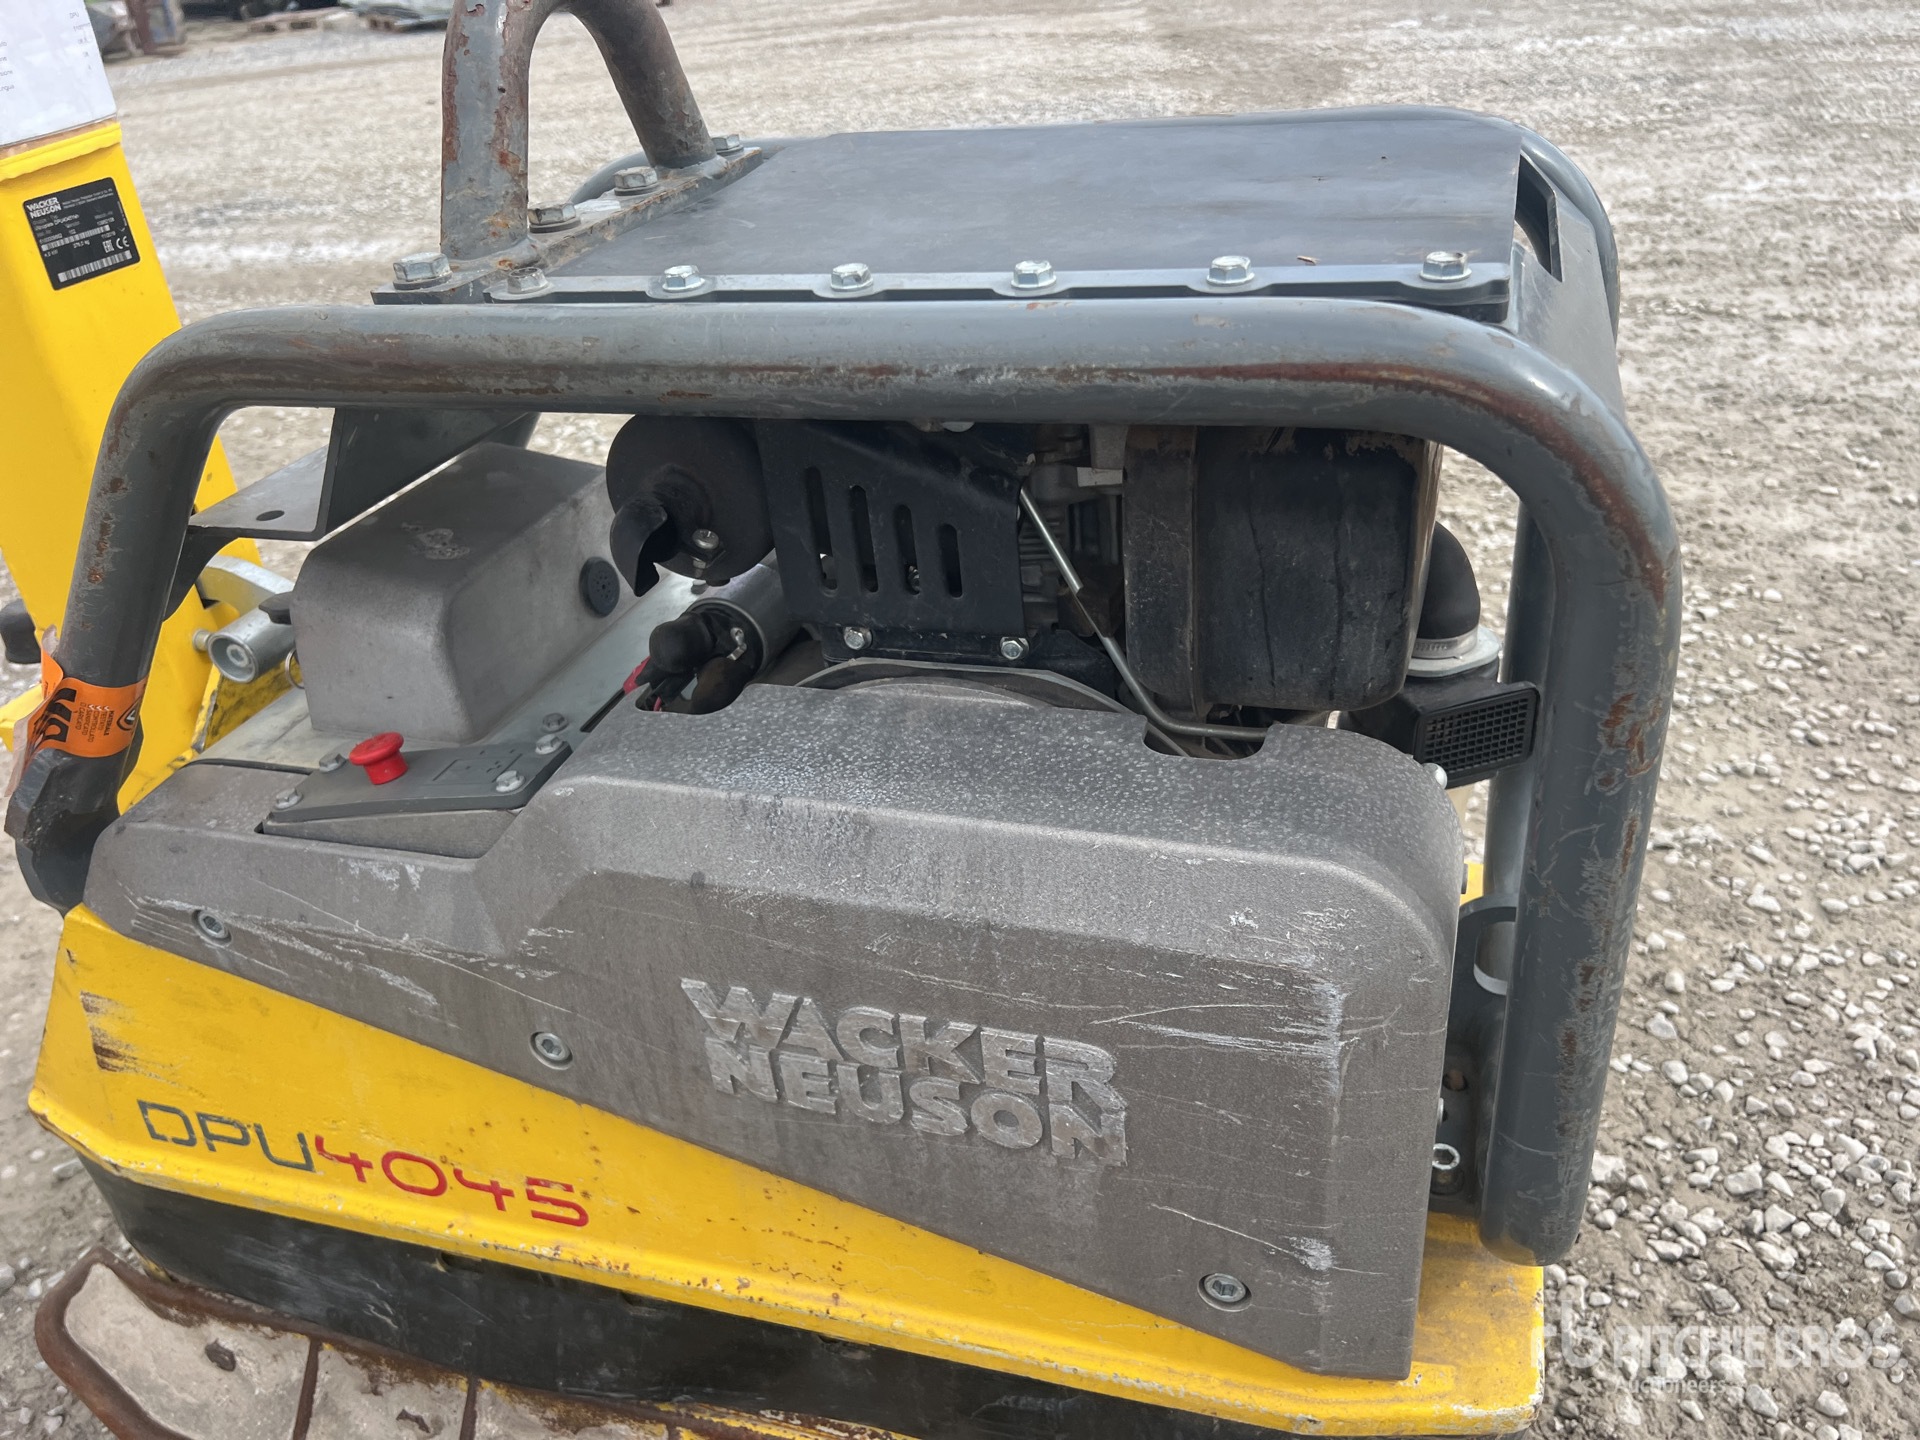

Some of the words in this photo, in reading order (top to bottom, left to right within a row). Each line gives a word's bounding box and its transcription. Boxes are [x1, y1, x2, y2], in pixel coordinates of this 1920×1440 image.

[26, 197, 60, 212] WACKER
[29, 204, 62, 219] NEUSON
[680, 977, 1127, 1110] WACKER
[704, 1036, 1128, 1167] NEUSON
